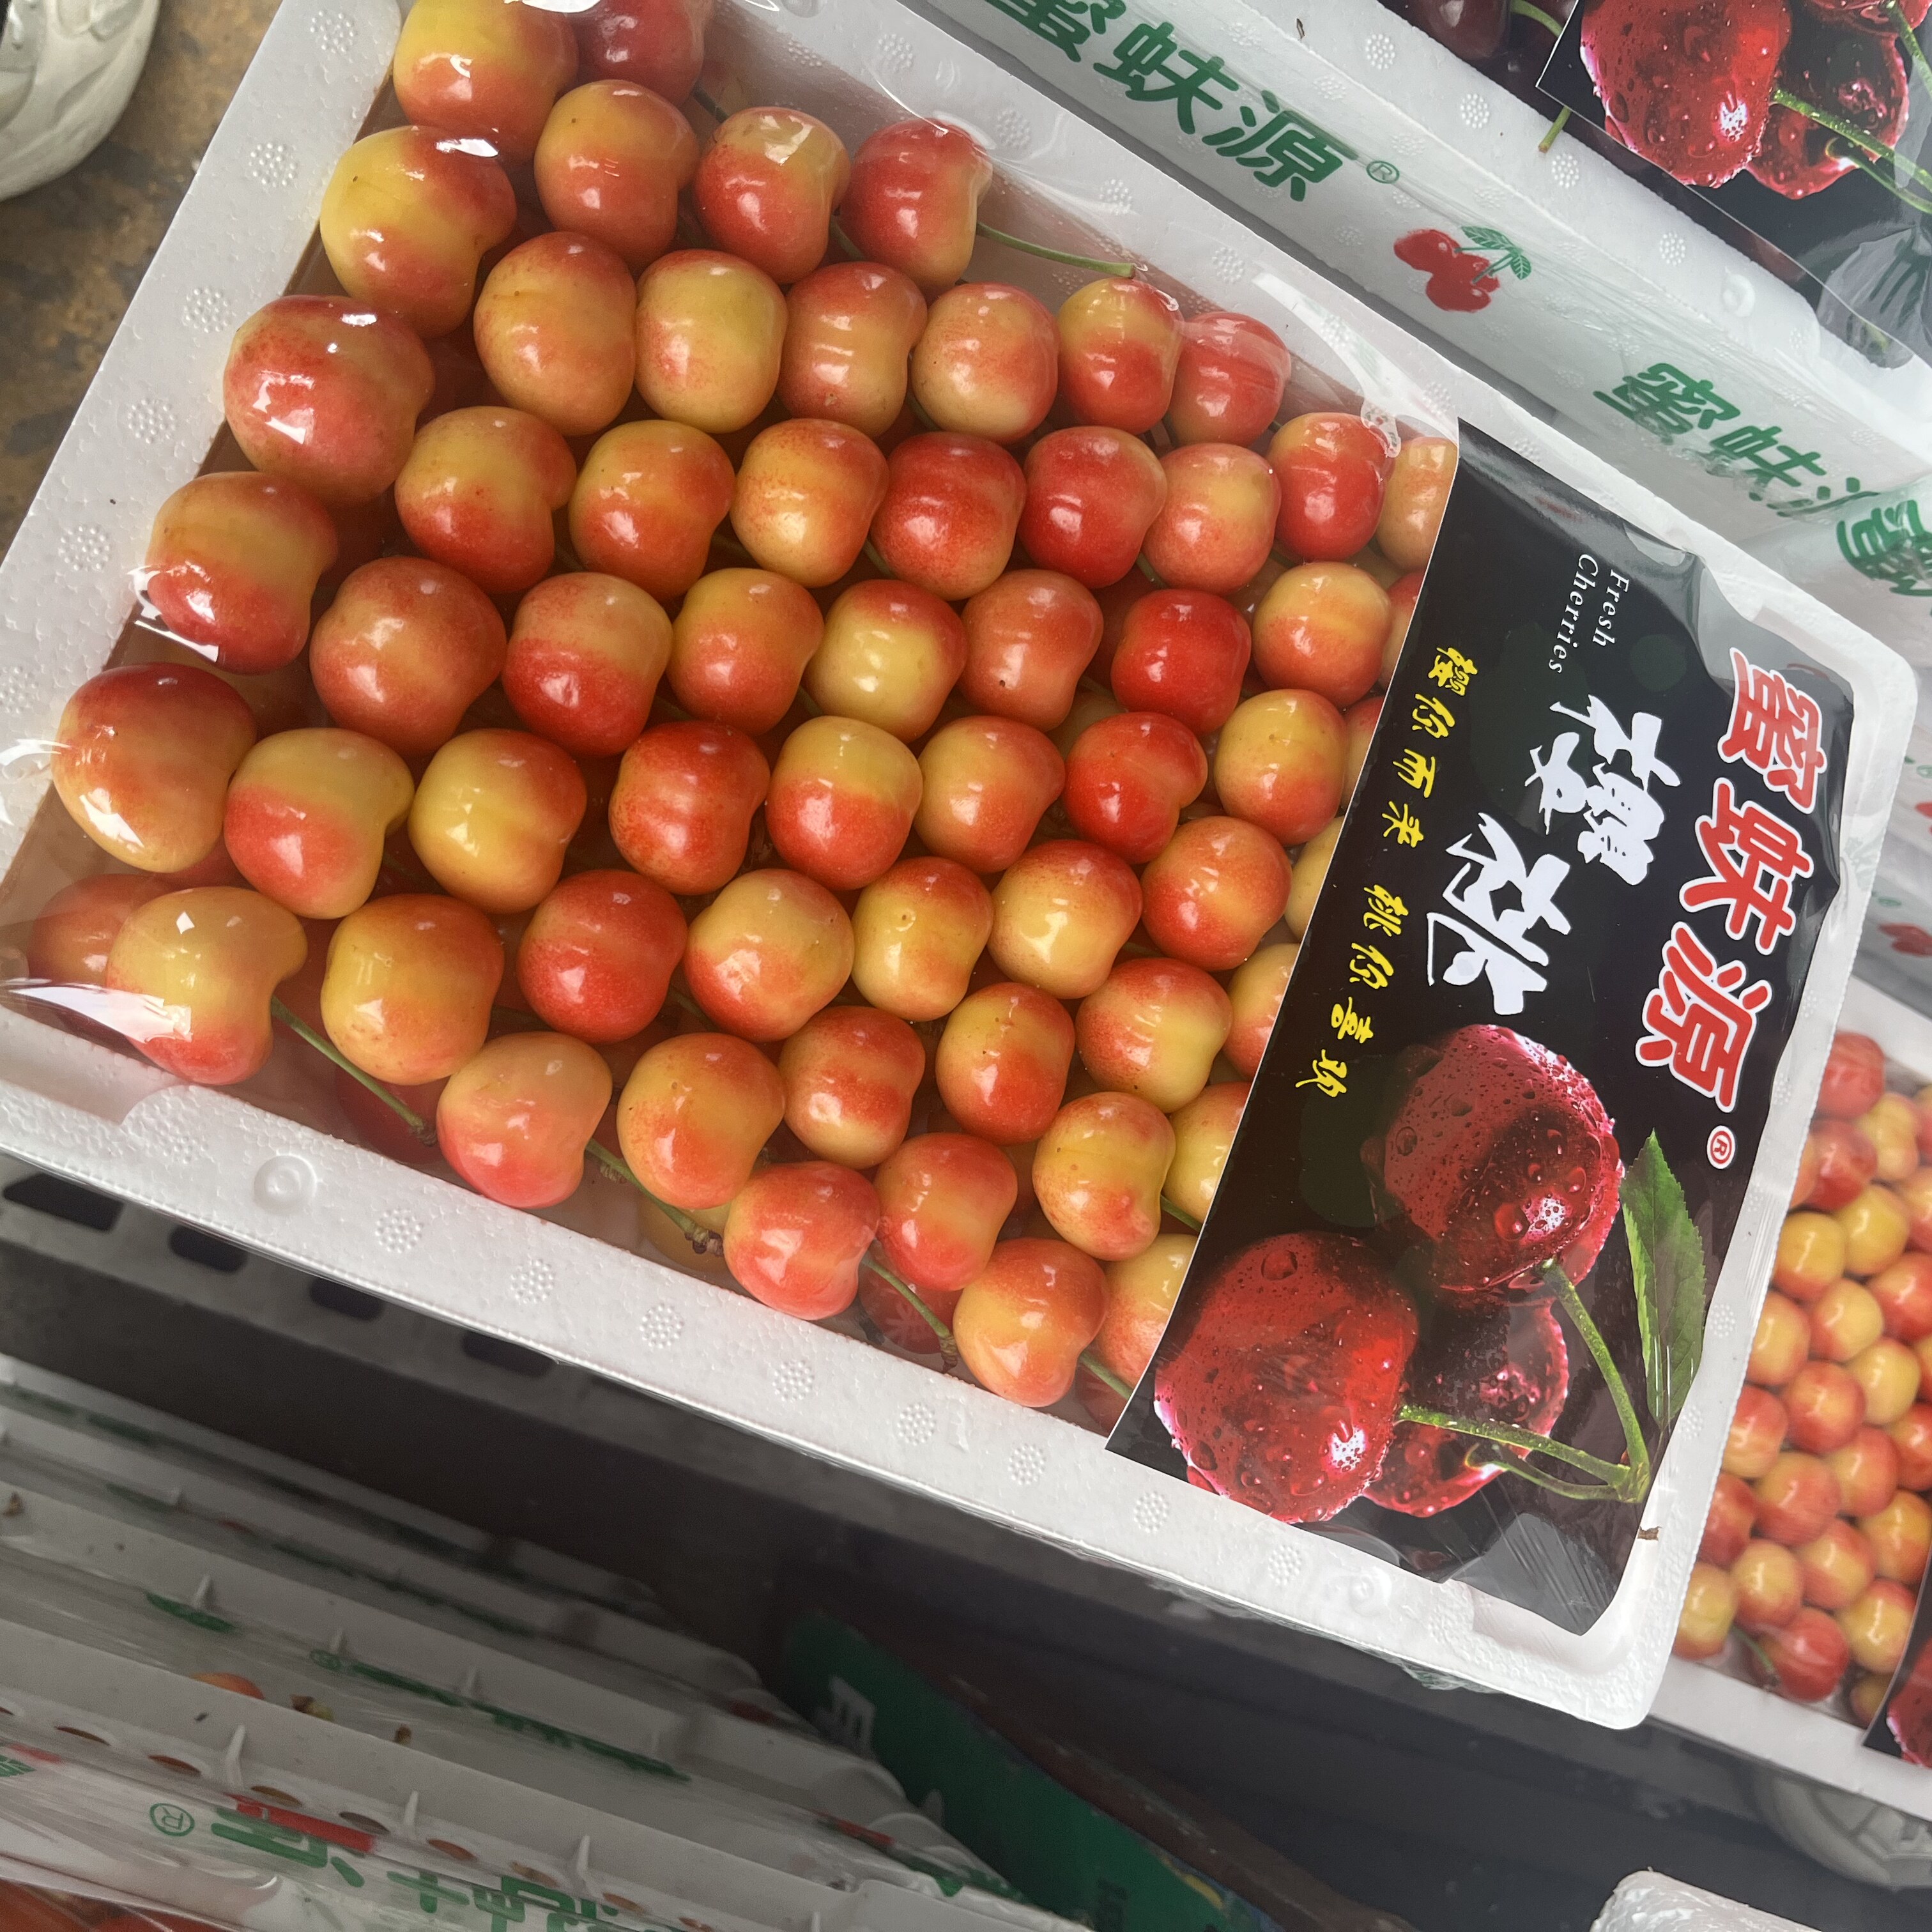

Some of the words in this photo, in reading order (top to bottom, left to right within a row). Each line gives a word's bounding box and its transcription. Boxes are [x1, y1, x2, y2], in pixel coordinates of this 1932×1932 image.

[1549, 554, 1598, 673] Cherries
[1592, 569, 1630, 647] Fresh
[1637, 648, 1826, 1112] 蜜蚨源
[1296, 884, 1409, 1098] 桃你喜欢
